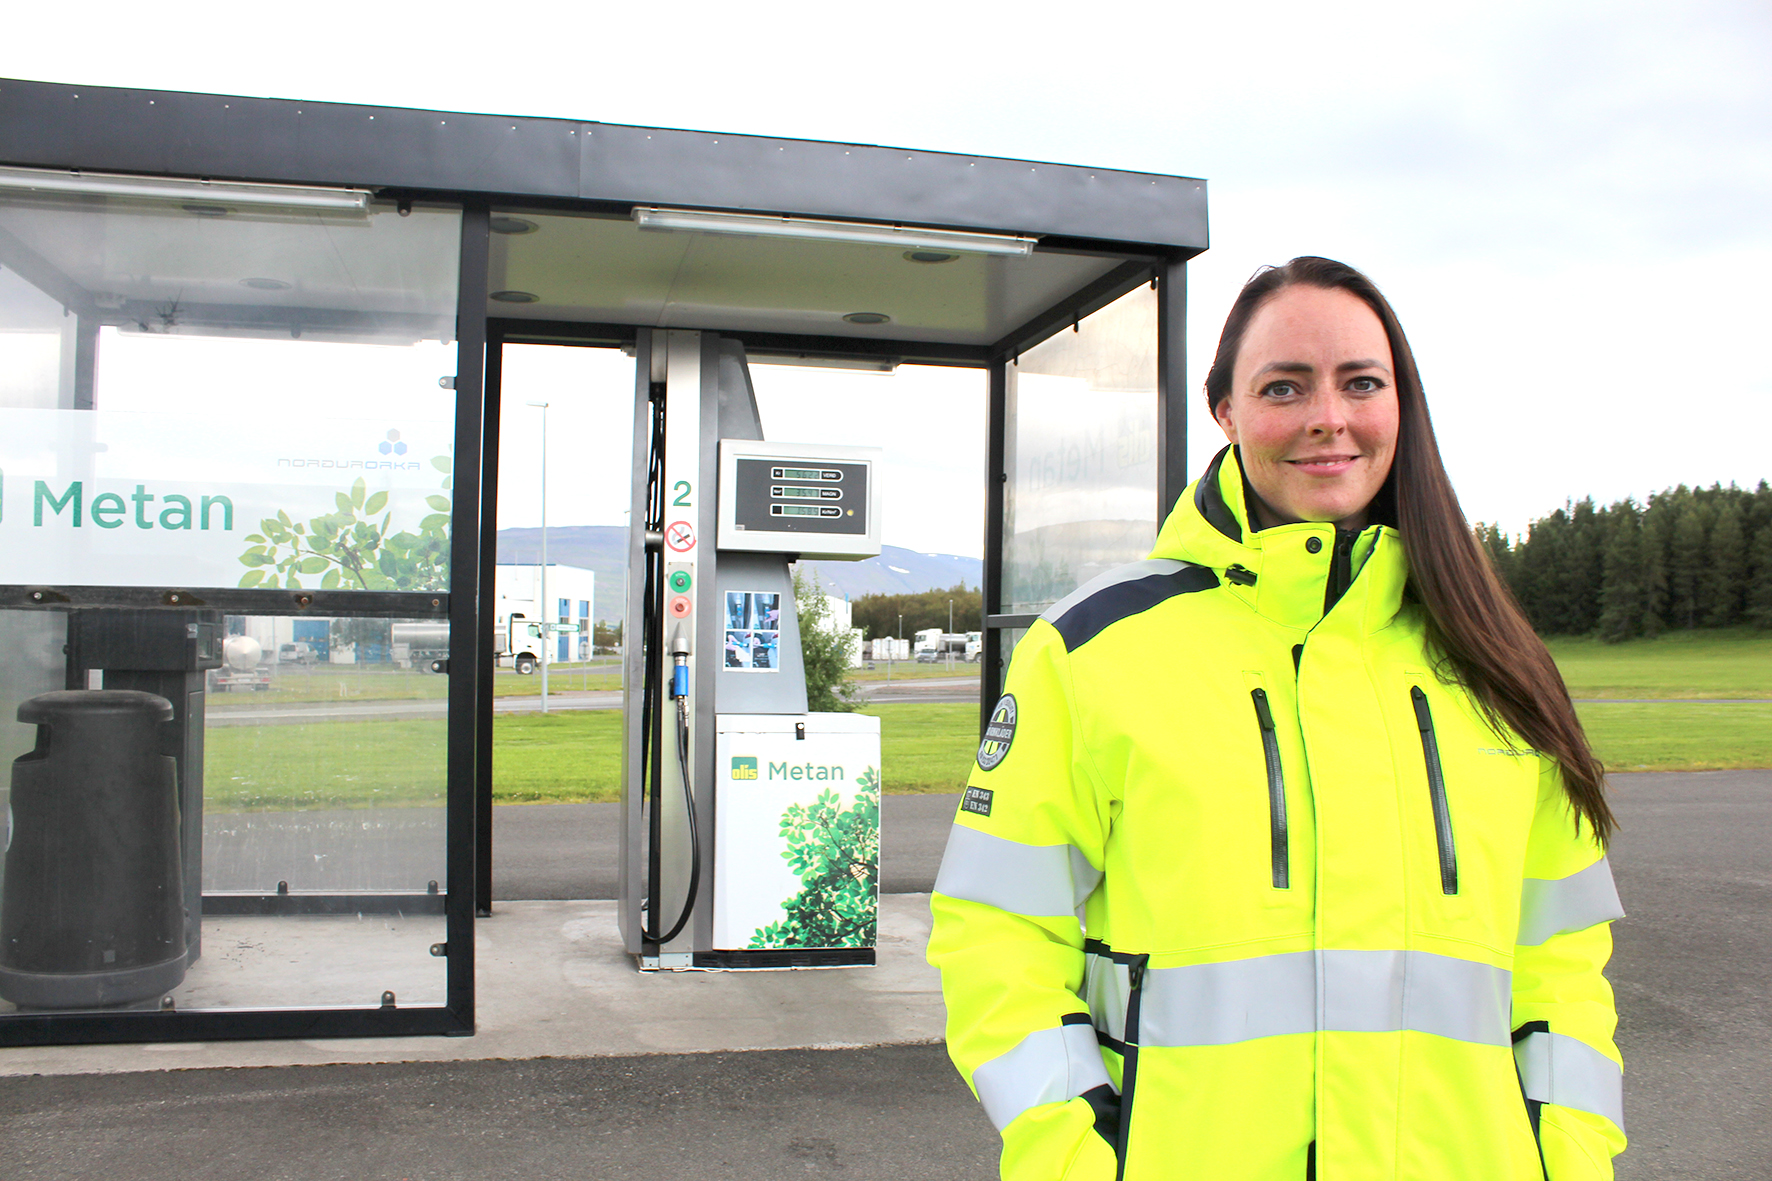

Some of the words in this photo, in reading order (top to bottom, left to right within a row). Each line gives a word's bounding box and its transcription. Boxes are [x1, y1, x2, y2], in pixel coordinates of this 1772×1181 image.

[33, 480, 234, 531] Metan
[673, 480, 691, 507] 2
[769, 761, 844, 781] Metan
